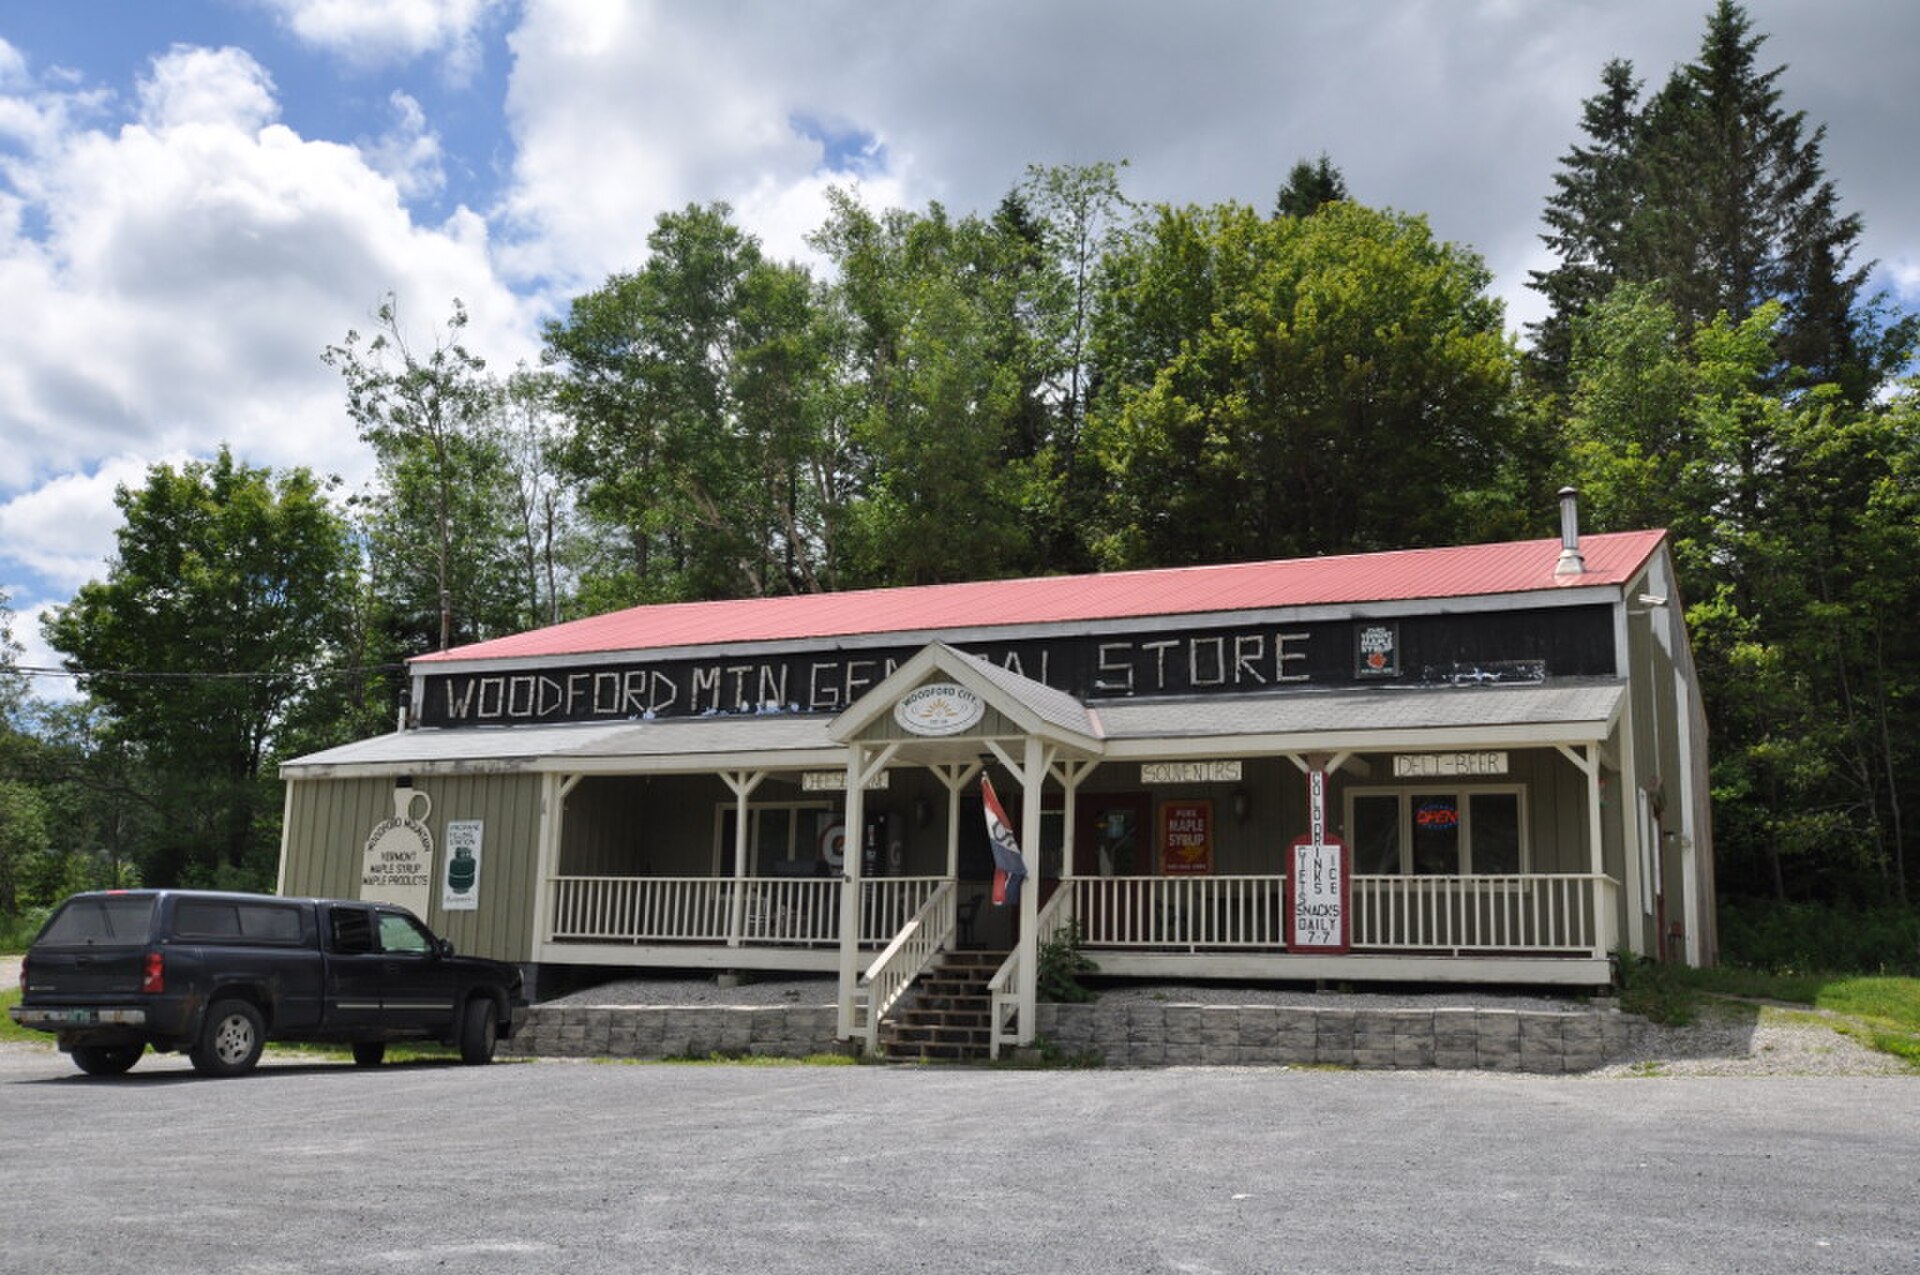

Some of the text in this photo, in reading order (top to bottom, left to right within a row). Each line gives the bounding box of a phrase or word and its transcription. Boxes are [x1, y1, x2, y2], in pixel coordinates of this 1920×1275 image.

[447, 670, 677, 719] WOODFORD
[691, 663, 788, 712] MTN
[1096, 633, 1310, 689] STORE
[903, 687, 977, 706] WOODFORD CITY
[1416, 810, 1459, 825] OPEN
[1169, 819, 1204, 832] MAPLE
[1169, 833, 1204, 847] SYRUP
[1313, 773, 1322, 895] COLD DRINKS
[381, 851, 417, 862] VERMONT
[370, 863, 421, 874] MAPLE SYRUP
[1329, 854, 1338, 895] ICE
[363, 875, 428, 886] MAPLE PRODUCTS
[1298, 918, 1335, 931] DAILY
[1308, 931, 1330, 943] 7-7
